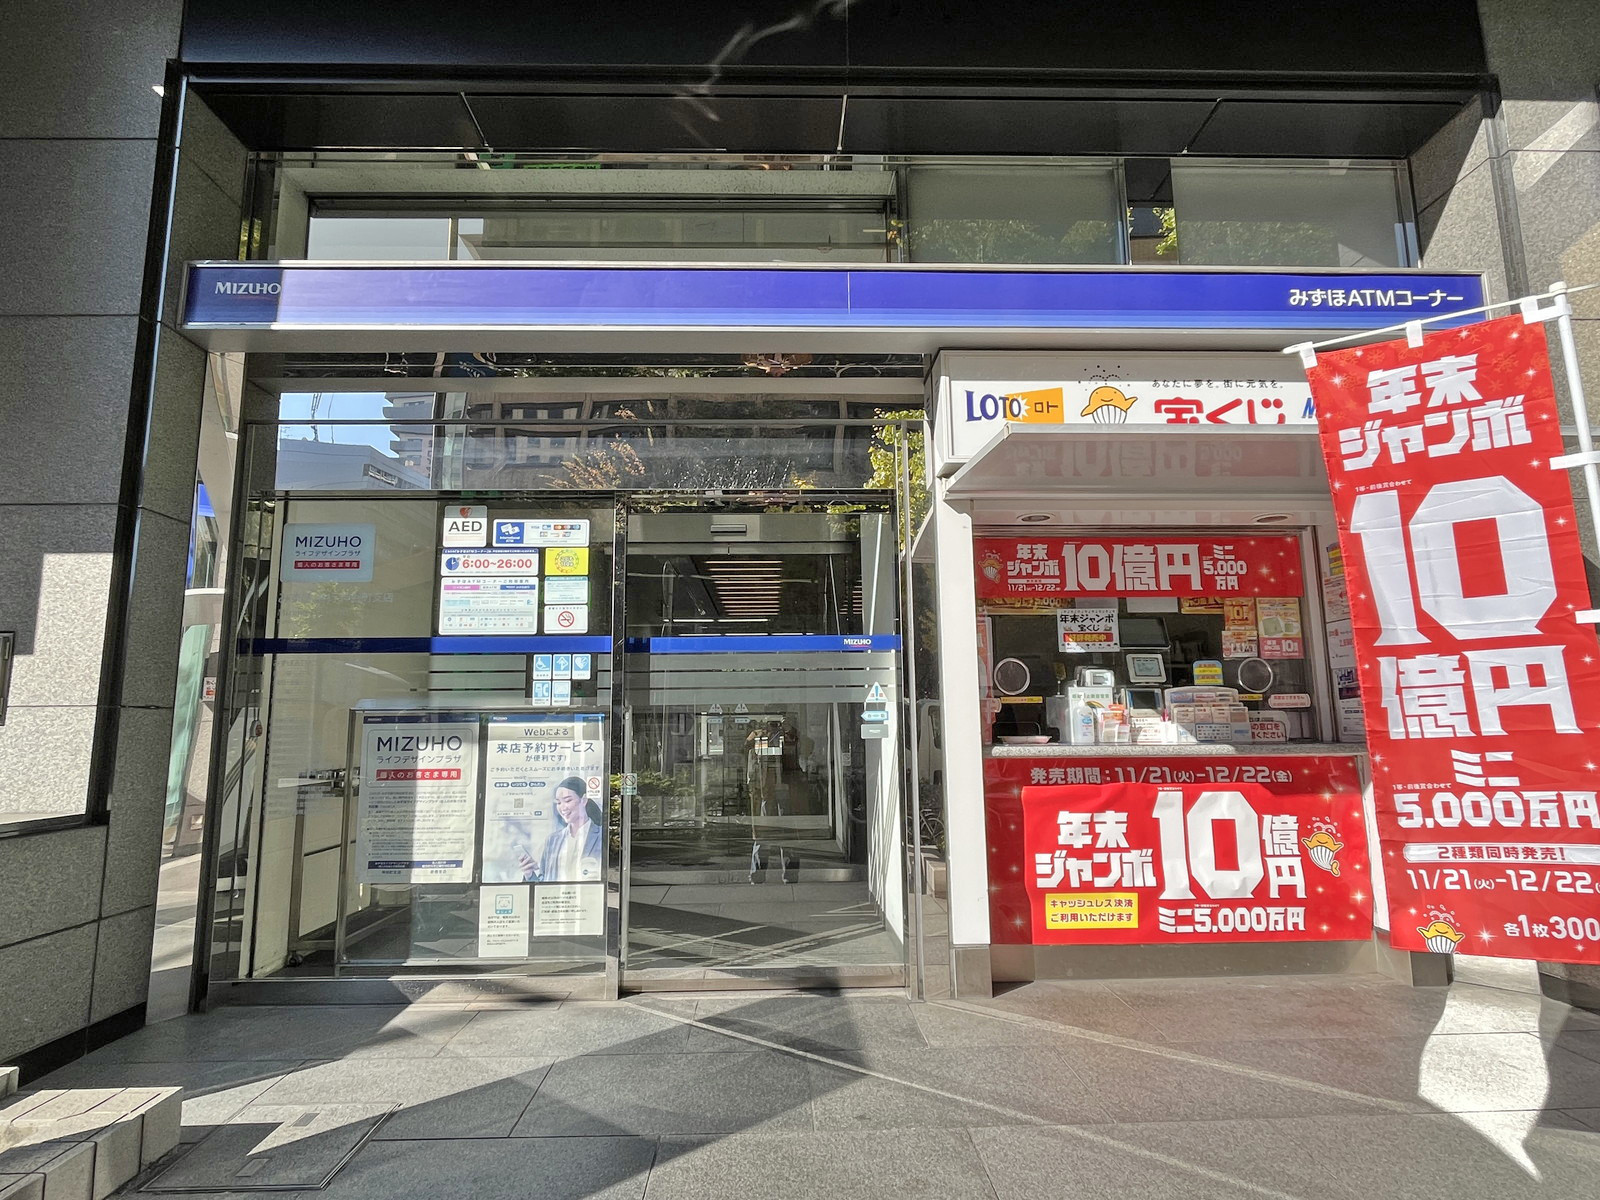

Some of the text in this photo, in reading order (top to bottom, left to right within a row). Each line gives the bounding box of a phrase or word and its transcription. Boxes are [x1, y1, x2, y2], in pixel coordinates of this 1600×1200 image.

[215, 281, 281, 295] MIZUHO
[1289, 288, 1464, 308] みずほATMコーナー
[1366, 353, 1483, 415] 年末
[965, 389, 1022, 422] LOTO
[1338, 394, 1532, 472] ジャンボ
[448, 521, 483, 532] AED
[295, 536, 362, 548] MIZUHO
[1017, 543, 1048, 559] 年末
[1007, 560, 1060, 576] ジャンボ
[1061, 544, 1203, 591] 10億円
[1350, 475, 1557, 646] 10
[1060, 613, 1114, 623] 年末ジャンボ
[1376, 645, 1584, 740] 億円
[524, 728, 569, 737] Webによる
[377, 736, 463, 752] MIZUHO
[496, 742, 595, 753] 来店予約サービス
[377, 755, 462, 764] ライフデザインプラザ
[379, 770, 458, 779] 個人のお客さま専用
[1450, 749, 1521, 787] ミニ
[1056, 810, 1130, 850] 年末
[1152, 790, 1264, 900] 10
[1035, 849, 1157, 888] ジャンボ
[1050, 899, 1133, 908] キャッシュレス決済
[1050, 913, 1133, 922] ご利用いただけます
